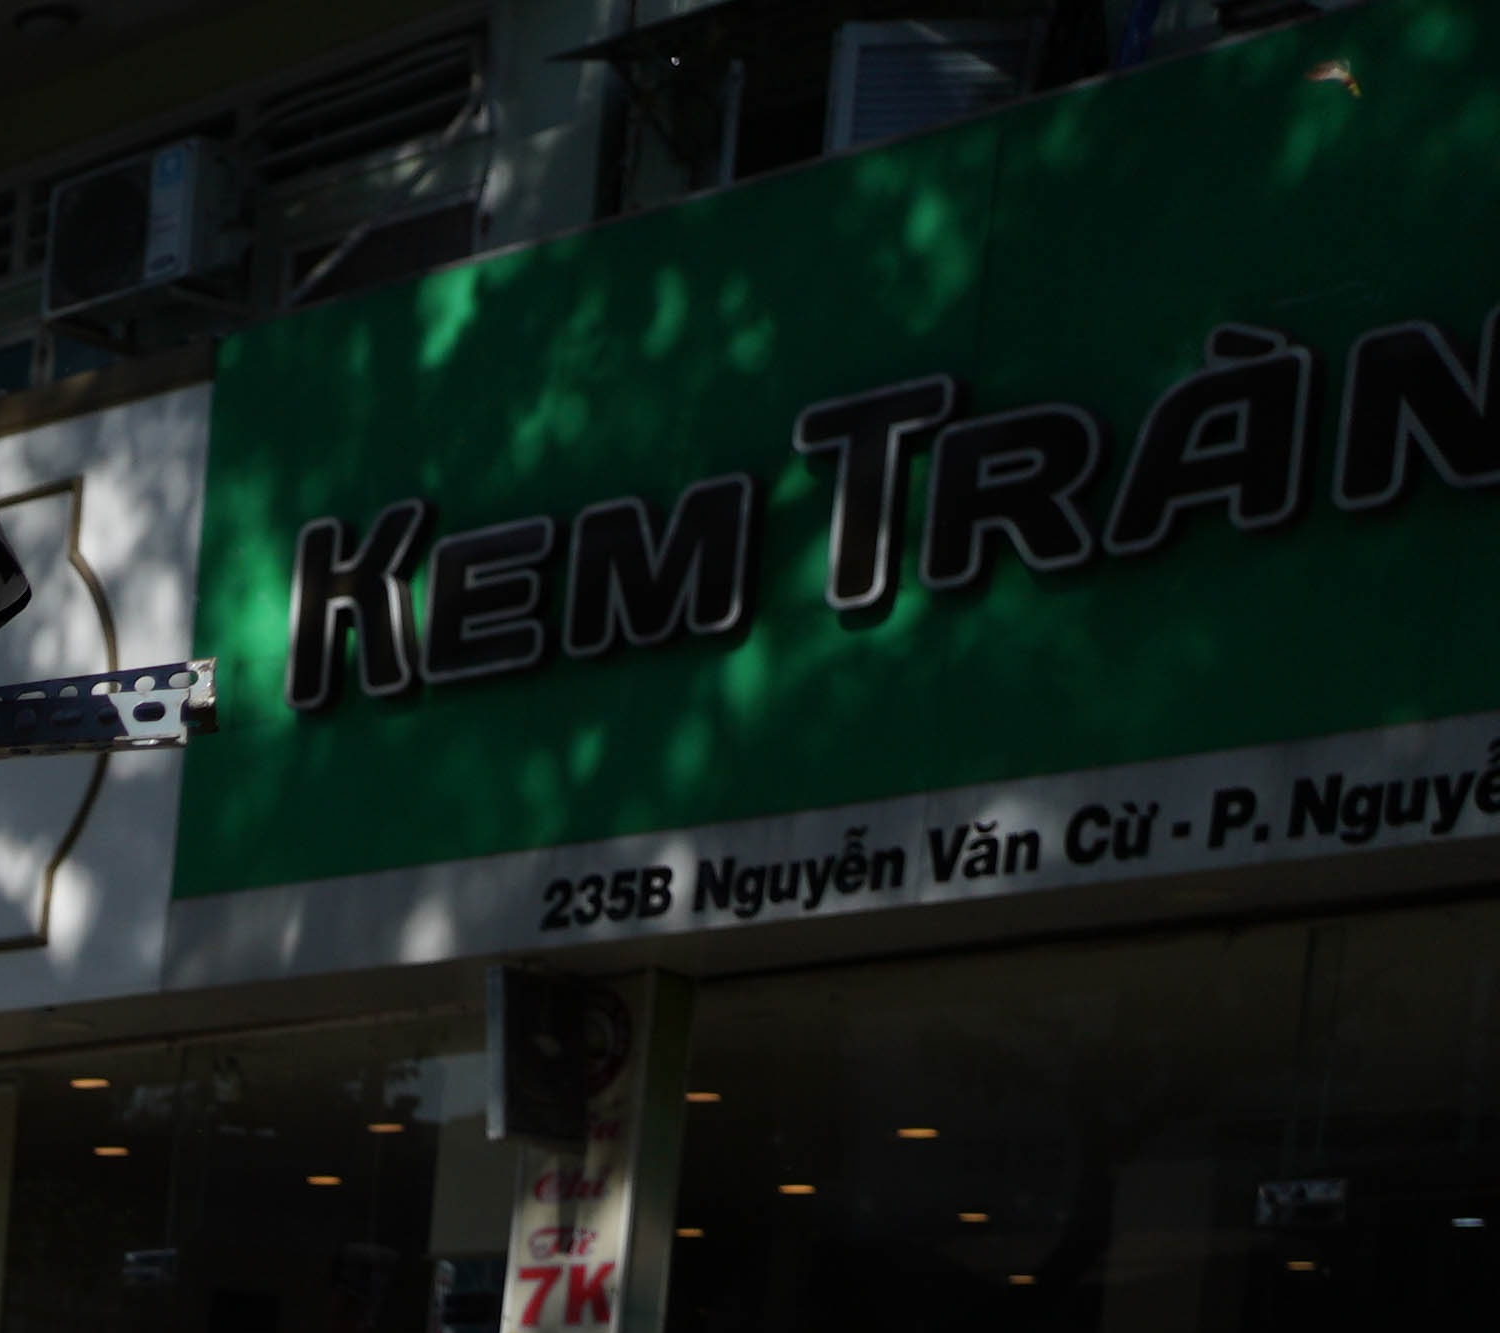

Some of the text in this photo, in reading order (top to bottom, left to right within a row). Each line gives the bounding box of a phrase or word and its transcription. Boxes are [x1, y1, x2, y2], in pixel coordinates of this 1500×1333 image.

[285, 472, 759, 710] KEM
[540, 865, 674, 931] 235B
[693, 824, 907, 920] Nguyễn
[928, 818, 1042, 883] Văn
[1064, 801, 1162, 868] Cừ
[1208, 788, 1269, 848] P.
[518, 1262, 615, 1326] 7K
